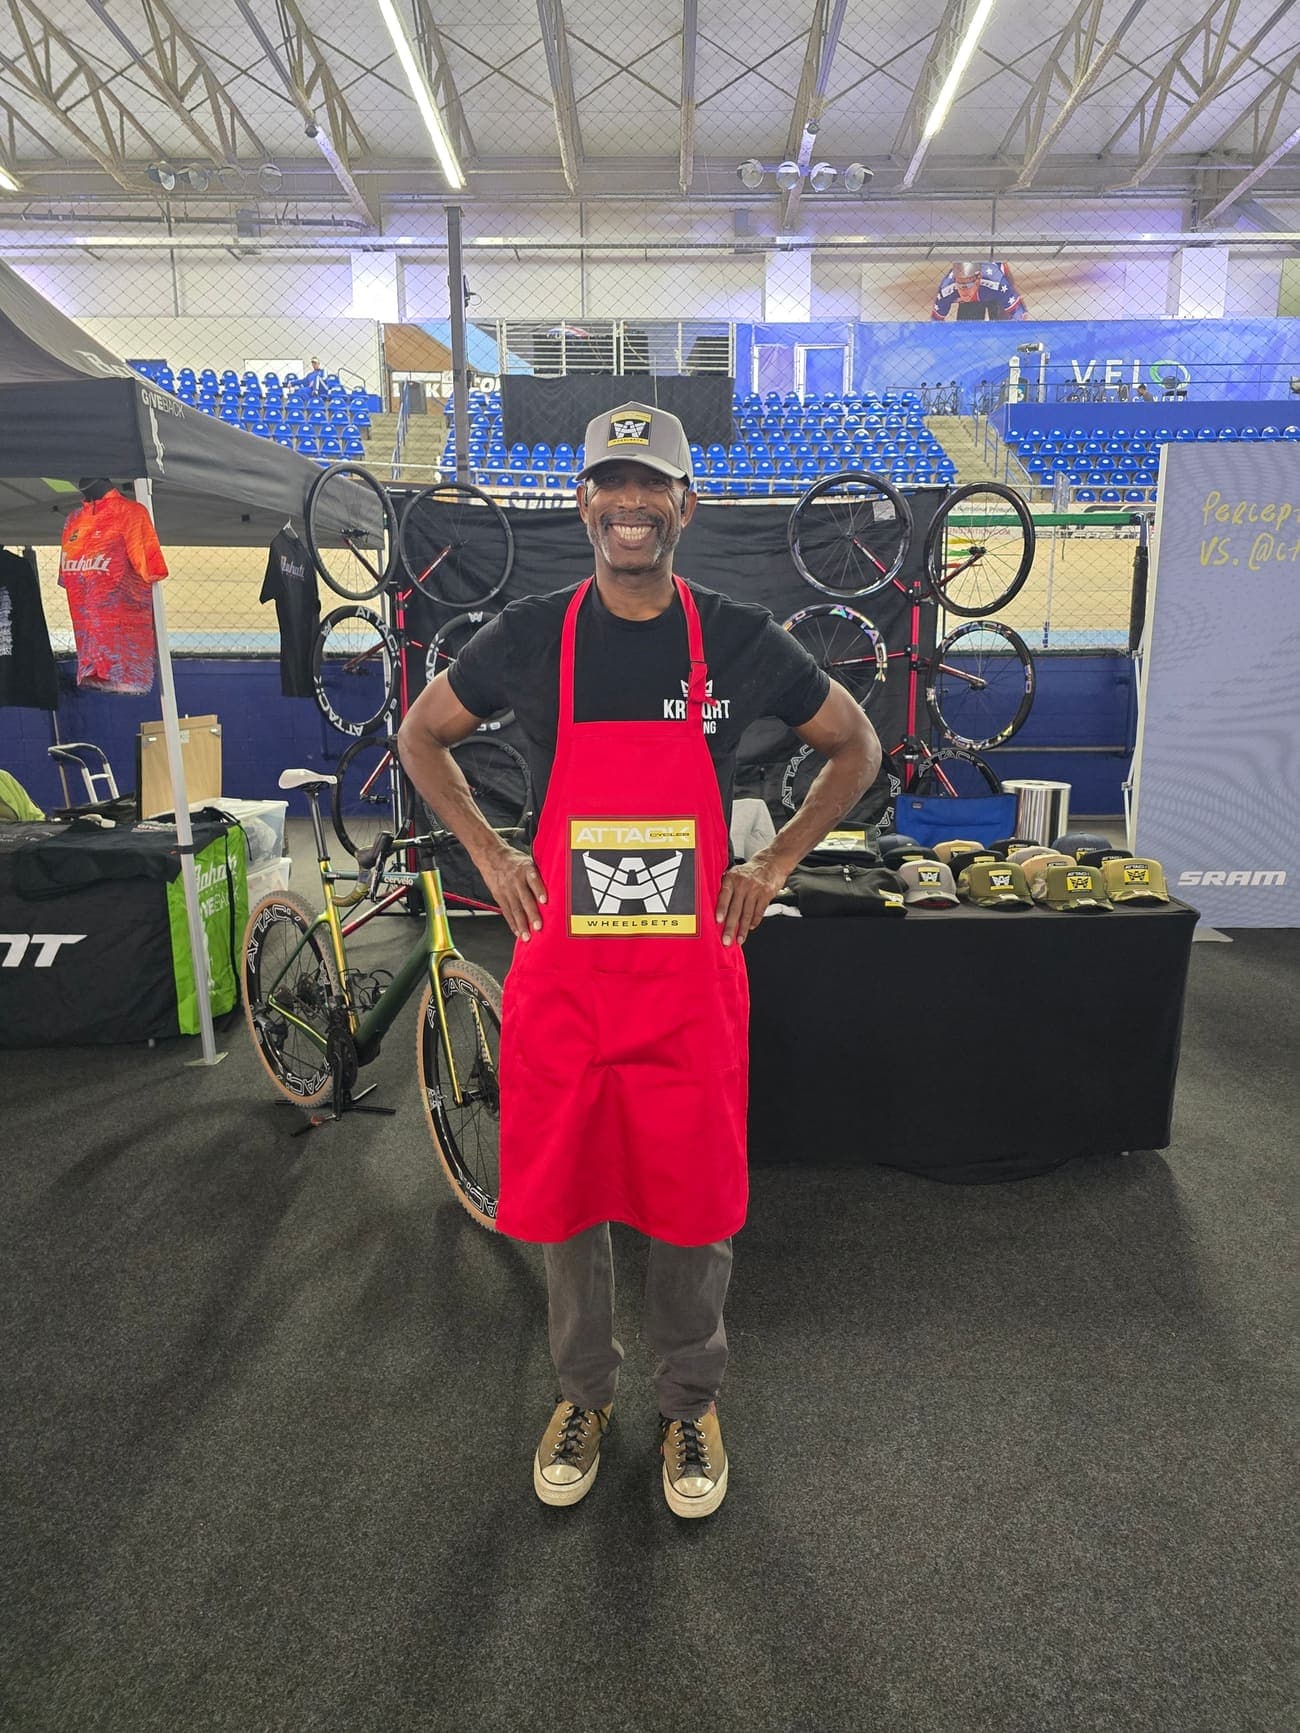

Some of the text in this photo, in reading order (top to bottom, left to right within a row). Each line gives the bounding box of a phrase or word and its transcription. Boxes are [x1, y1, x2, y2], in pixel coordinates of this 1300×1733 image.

[781, 744, 815, 813] ATTAC
[1177, 870, 1287, 886] SRAM
[587, 918, 680, 928] WHEELSETS
